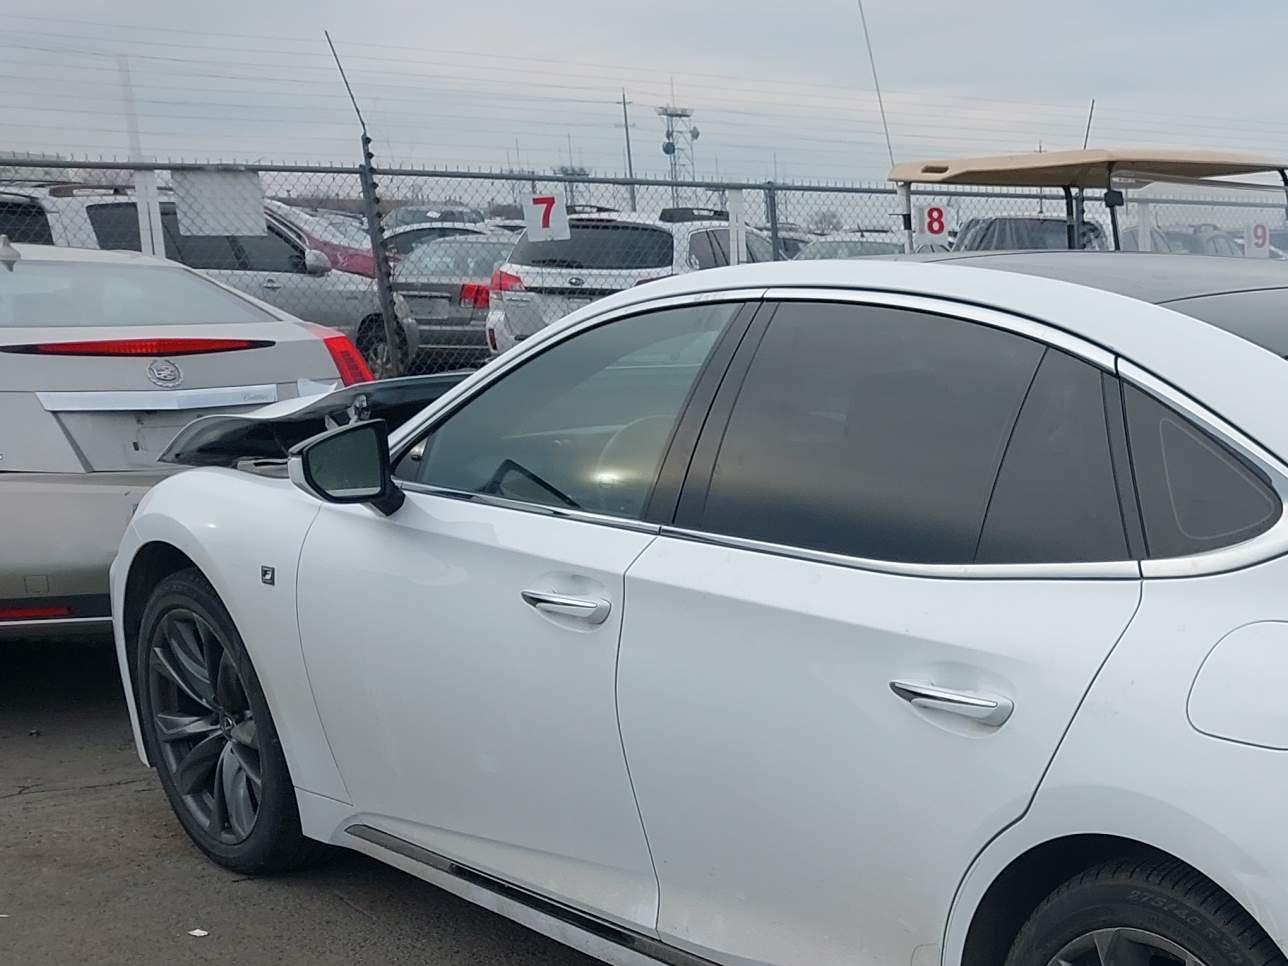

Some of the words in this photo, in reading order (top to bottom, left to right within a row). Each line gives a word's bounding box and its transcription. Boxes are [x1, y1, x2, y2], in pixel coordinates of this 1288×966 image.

[531, 195, 556, 229] 7
[926, 206, 945, 236] 8
[1252, 223, 1267, 249] 9
